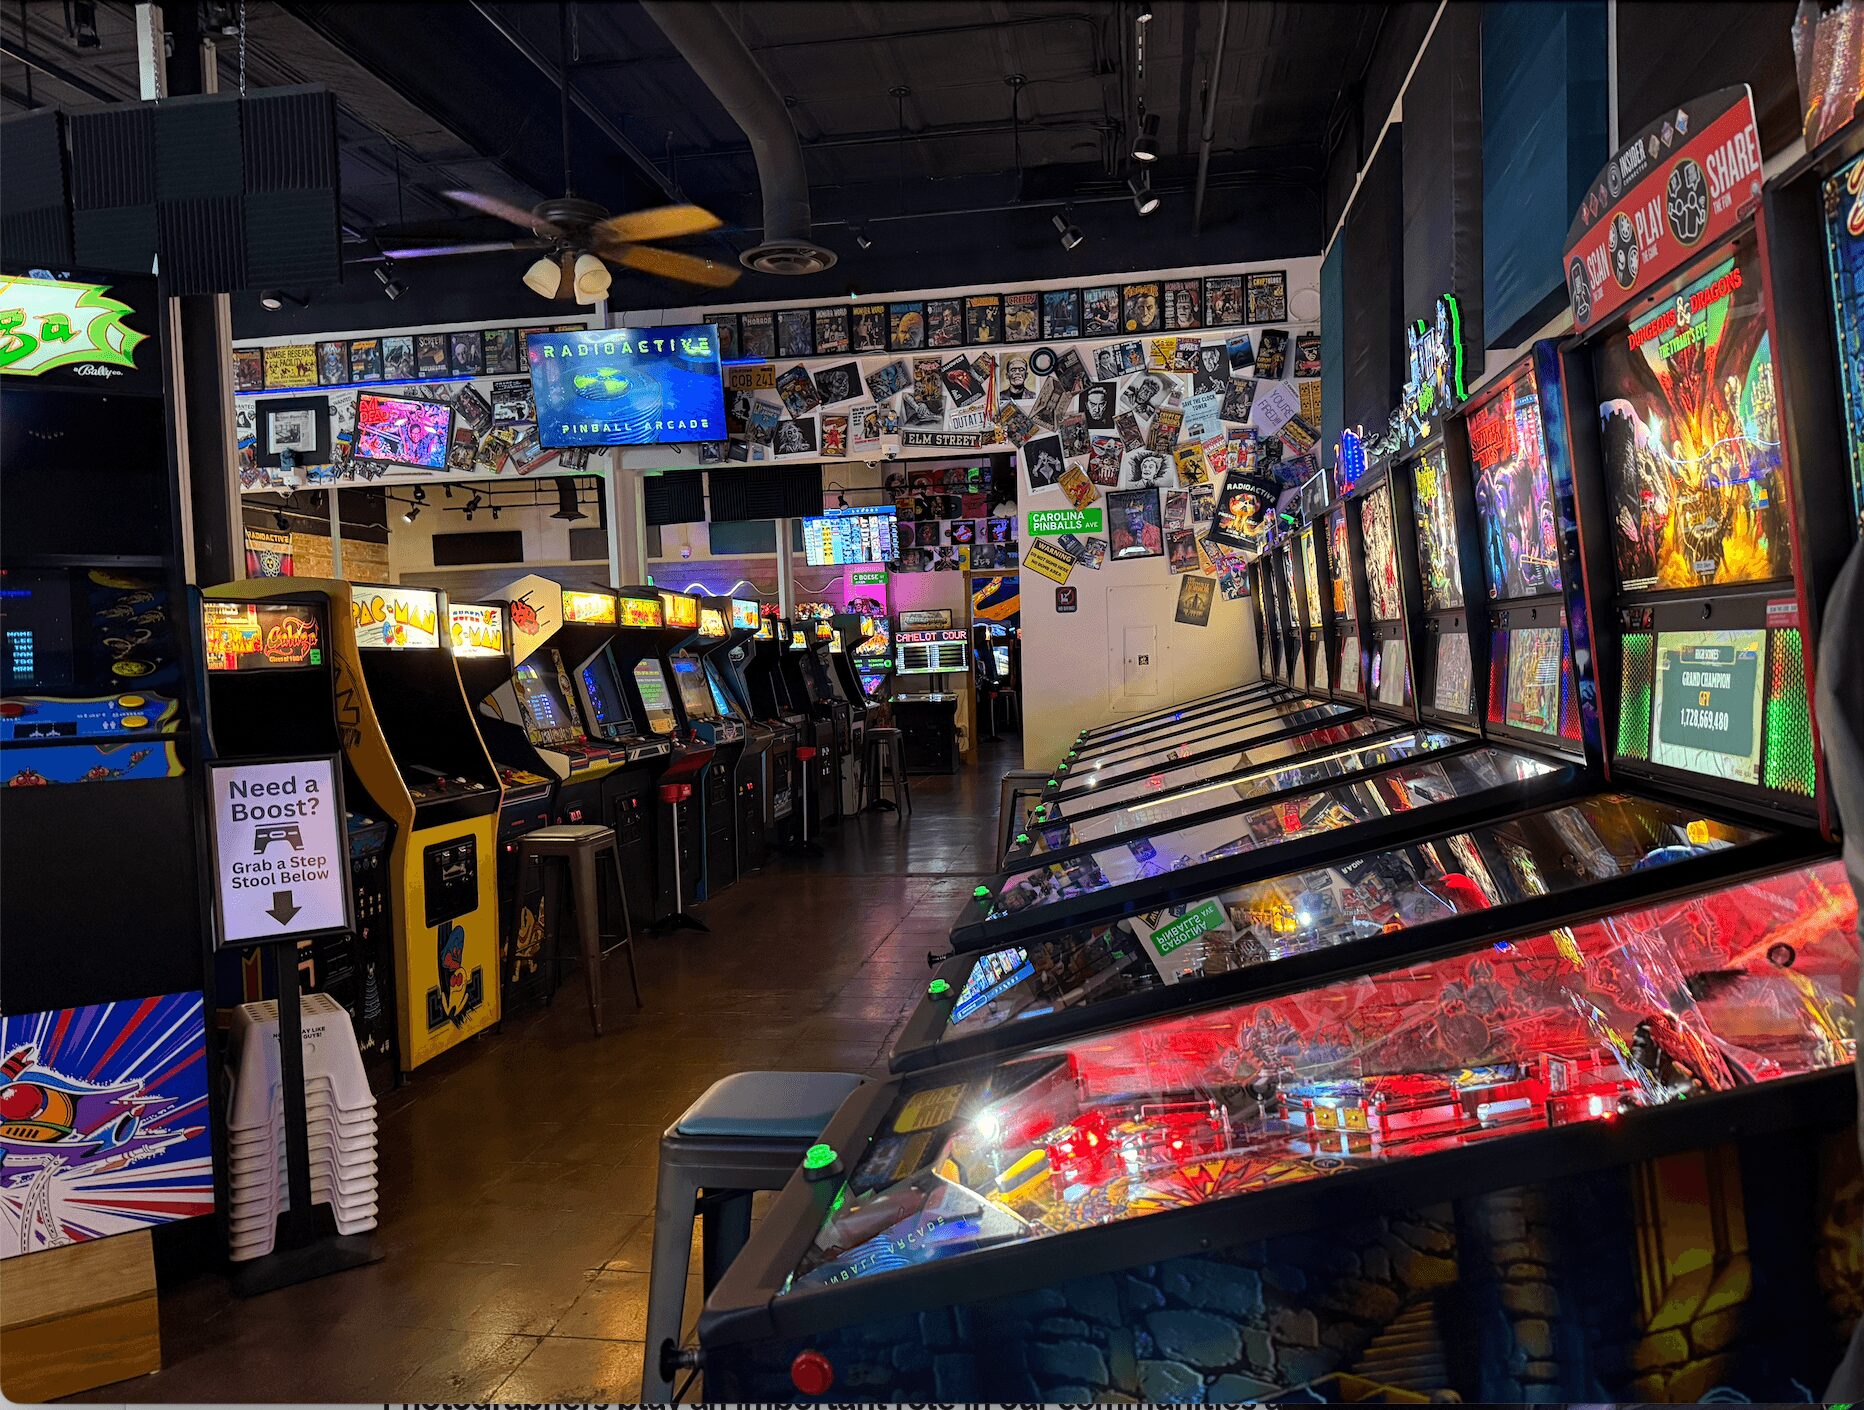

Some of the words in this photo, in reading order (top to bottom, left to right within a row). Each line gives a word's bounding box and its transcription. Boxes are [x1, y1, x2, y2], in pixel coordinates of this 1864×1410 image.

[1618, 138, 1646, 178] INSIDER
[1706, 126, 1759, 198] SHARE
[1635, 194, 1664, 250] PLAY
[1586, 242, 1610, 290] SCAN
[1627, 308, 1677, 351] DUNGEONS
[1676, 296, 1691, 327] &
[1690, 267, 1743, 315] DRAGONS
[265, 350, 287, 360] ZOMBIE
[287, 349, 315, 358] RESEARCH
[543, 337, 710, 359] RADIOACTIVE
[78, 363, 112, 379] Bally
[731, 375, 753, 388] COB
[756, 373, 774, 386] 241
[1182, 400, 1192, 408] SAVE
[1201, 394, 1216, 402] CLOCK
[1192, 403, 1207, 411] TOWER
[561, 420, 632, 434] PINBALL
[644, 419, 710, 431] ARCADE
[908, 432, 932, 445] ELM
[935, 434, 977, 447] STREET
[1226, 482, 1276, 504] RADIOACTIVE
[1033, 511, 1085, 523] CAROLINA
[1033, 520, 1082, 532] PINBALLS
[247, 531, 289, 543] RADIOACTIVE
[1038, 542, 1072, 563] WARNING
[351, 595, 436, 636] PAC-MAN
[895, 632, 937, 643] CAMELOT
[942, 630, 968, 640] COUR
[1681, 671, 1701, 687] GRAND
[1700, 672, 1731, 689] CHAMPION
[1680, 708, 1729, 731] 1,728,669,480
[229, 775, 297, 799] Need
[305, 779, 320, 793] a
[231, 797, 320, 822] Boost?
[232, 859, 272, 874] Grab
[277, 860, 286, 870] a
[290, 854, 327, 869] Step
[232, 873, 276, 889] Stool
[281, 869, 329, 884] Below
